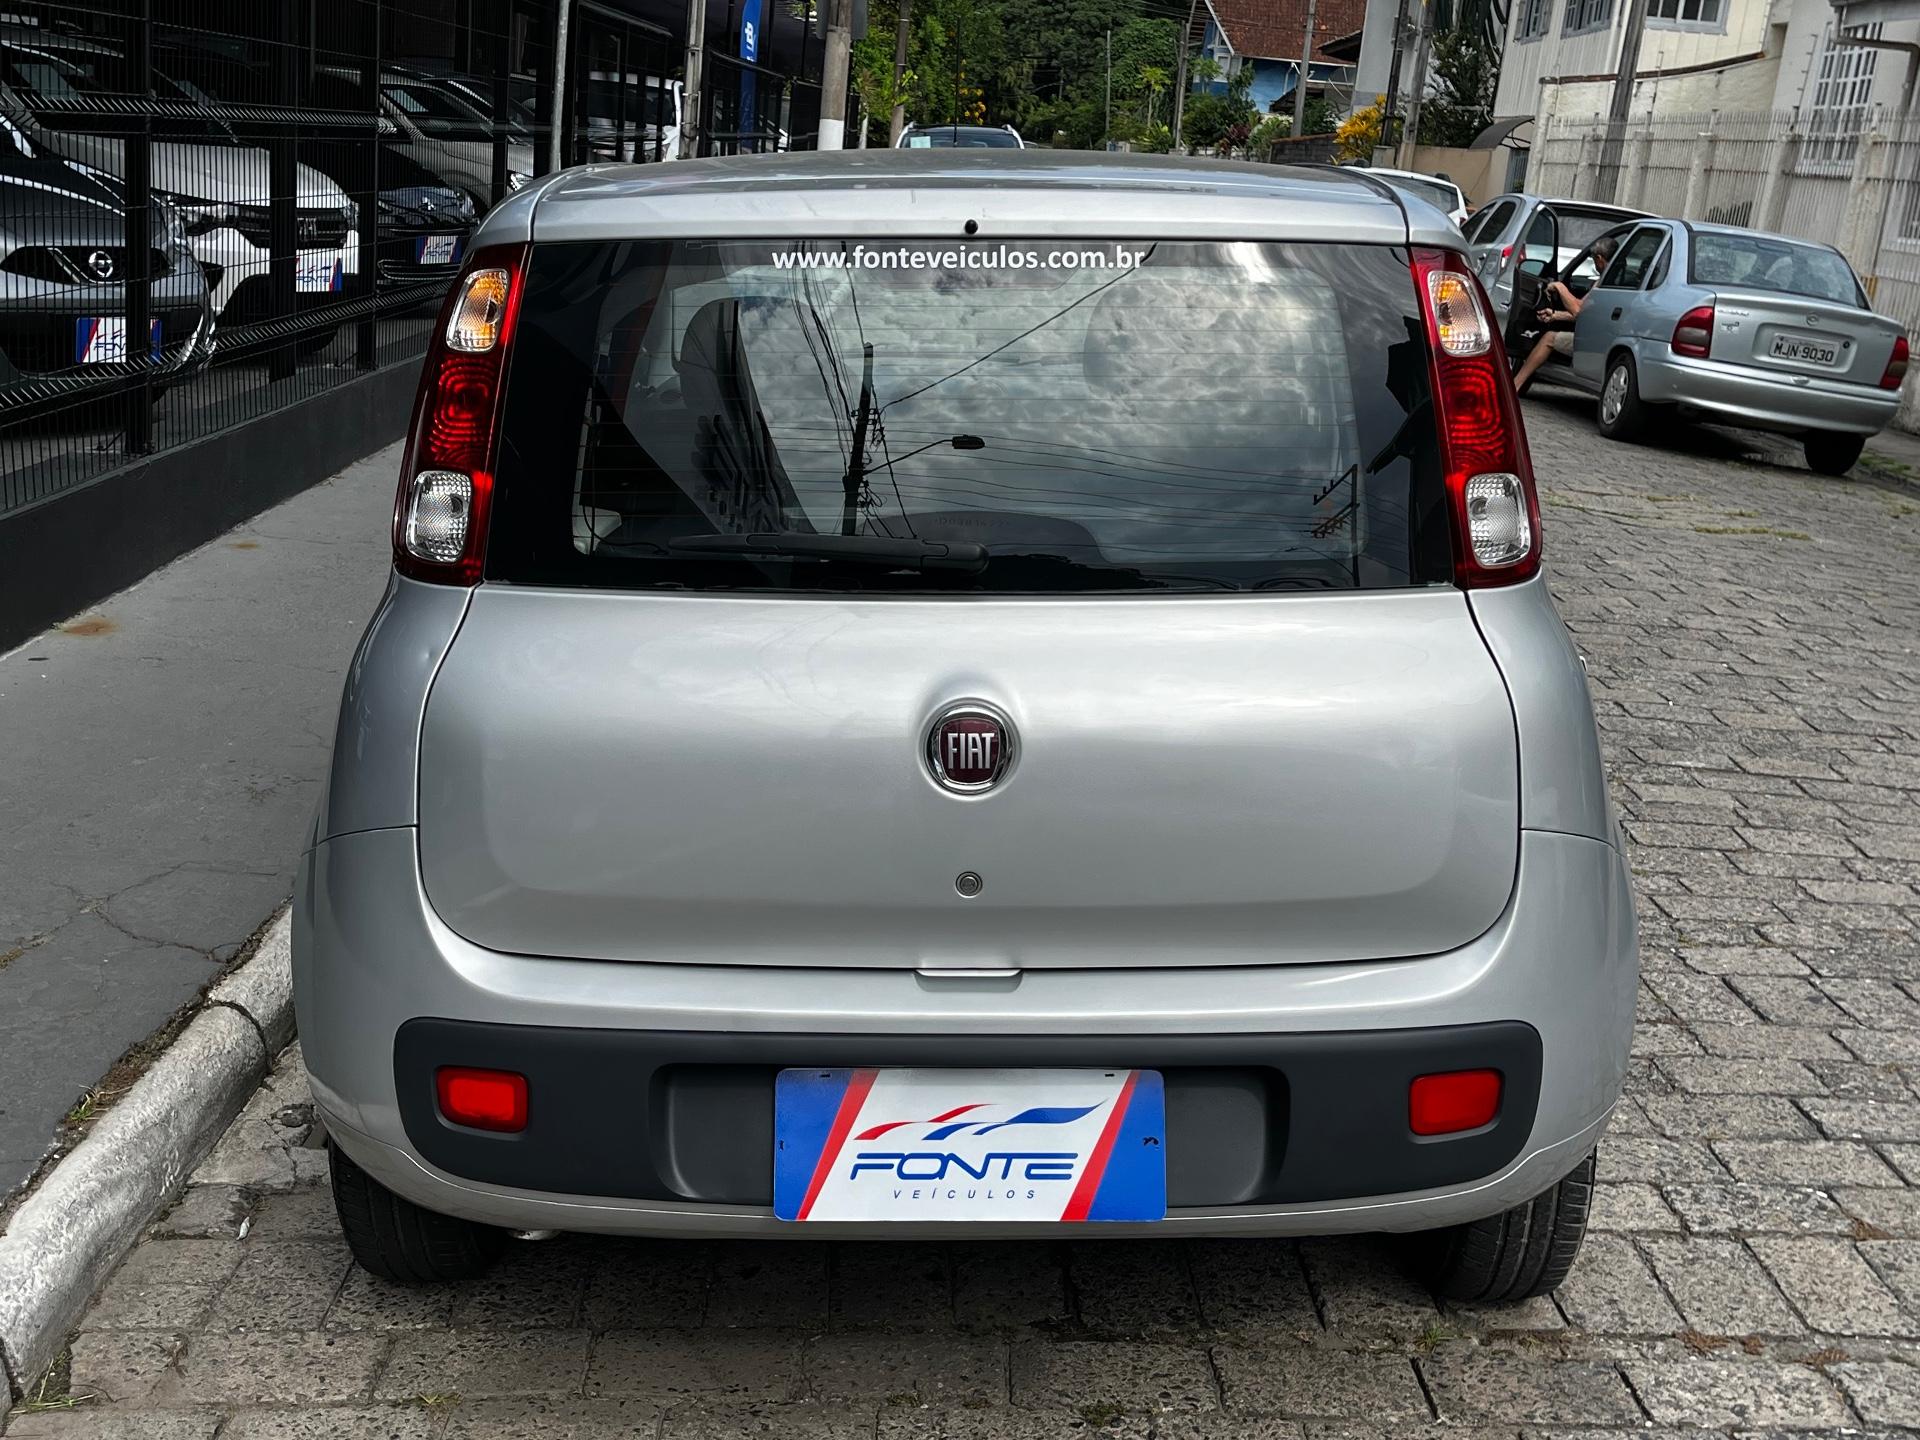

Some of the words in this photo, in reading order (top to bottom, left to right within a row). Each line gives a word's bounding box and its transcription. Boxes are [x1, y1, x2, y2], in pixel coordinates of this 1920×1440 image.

[772, 245, 1145, 270] www.fonteveiculos.com.br
[947, 732, 995, 769] FIAT
[849, 1152, 1078, 1180] FONTE
[893, 1187, 1036, 1200] VEÍCULOS
